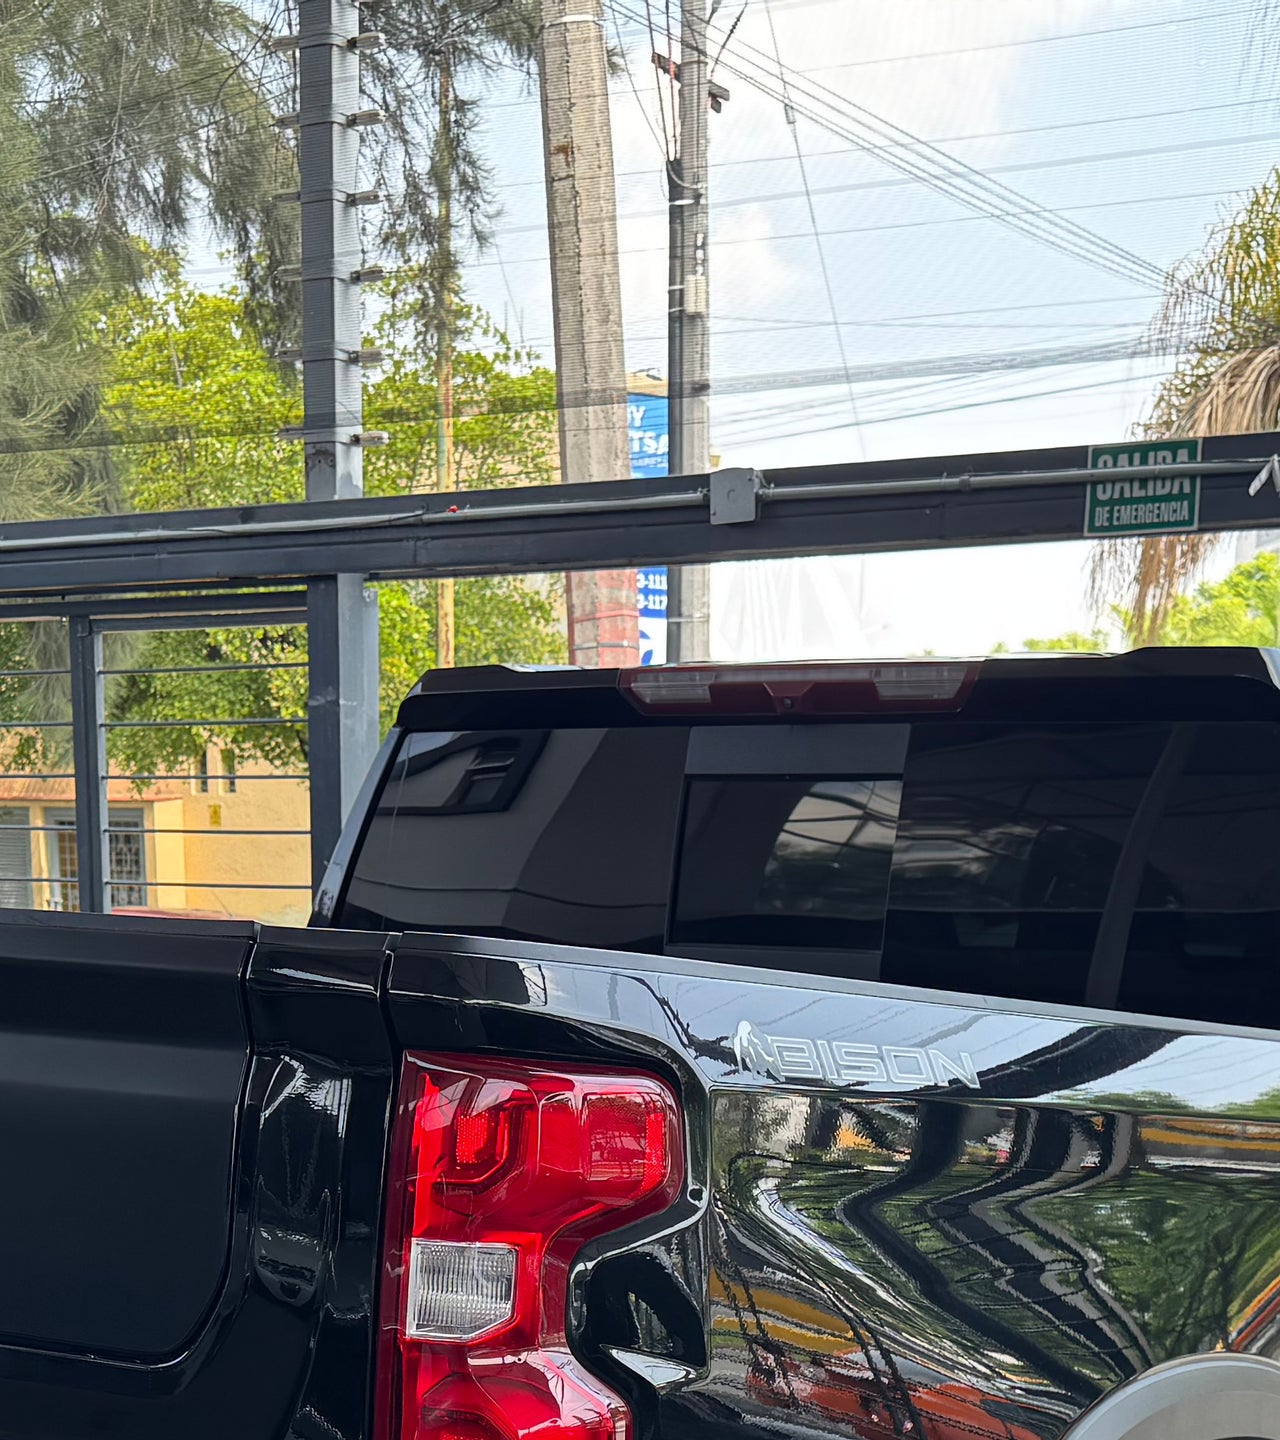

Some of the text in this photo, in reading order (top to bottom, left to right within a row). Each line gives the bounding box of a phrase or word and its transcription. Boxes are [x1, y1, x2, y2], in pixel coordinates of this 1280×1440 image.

[1096, 448, 1191, 501] SALIDA
[1095, 501, 1189, 527] DE EMERGENCIA
[768, 1036, 980, 1089] BISON
